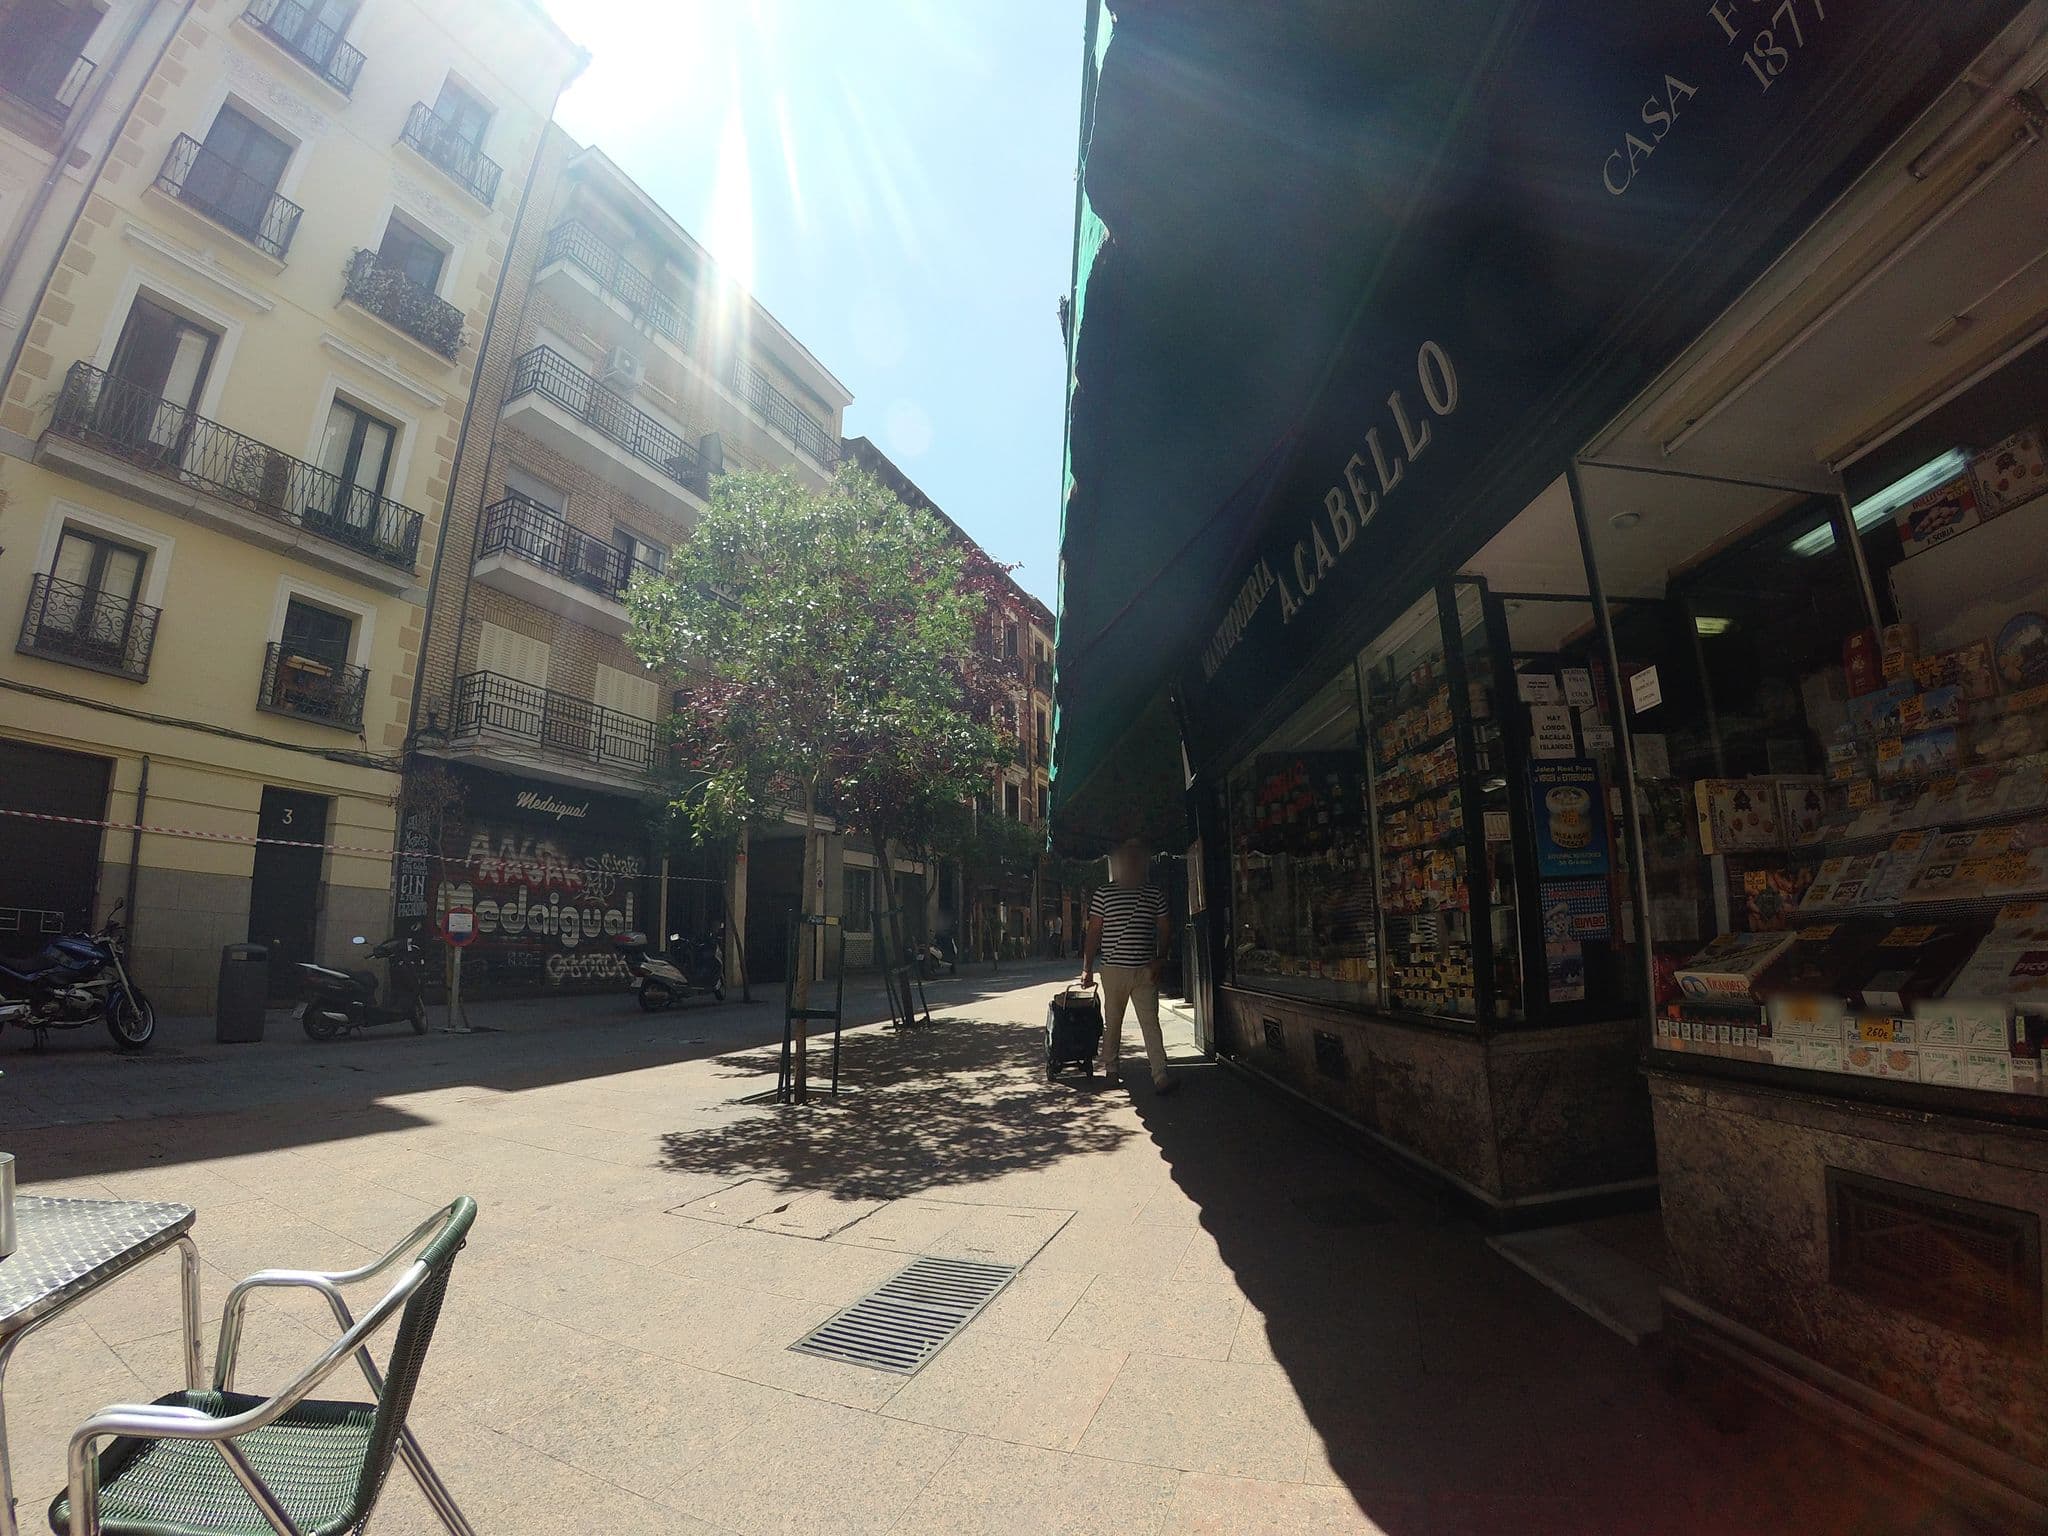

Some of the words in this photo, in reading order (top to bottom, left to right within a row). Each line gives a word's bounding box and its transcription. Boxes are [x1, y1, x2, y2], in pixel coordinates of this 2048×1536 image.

[1603, 73, 1699, 195] CASA
[1293, 340, 1459, 597] CABELLO
[282, 808, 293, 825] 3
[516, 791, 590, 821] Medaigual
[1928, 866, 1953, 876] PICO
[401, 874, 426, 896] GIN
[435, 881, 635, 948] Medaigual
[1574, 915, 1606, 928] BIMBO
[2015, 961, 2048, 971] PICO
